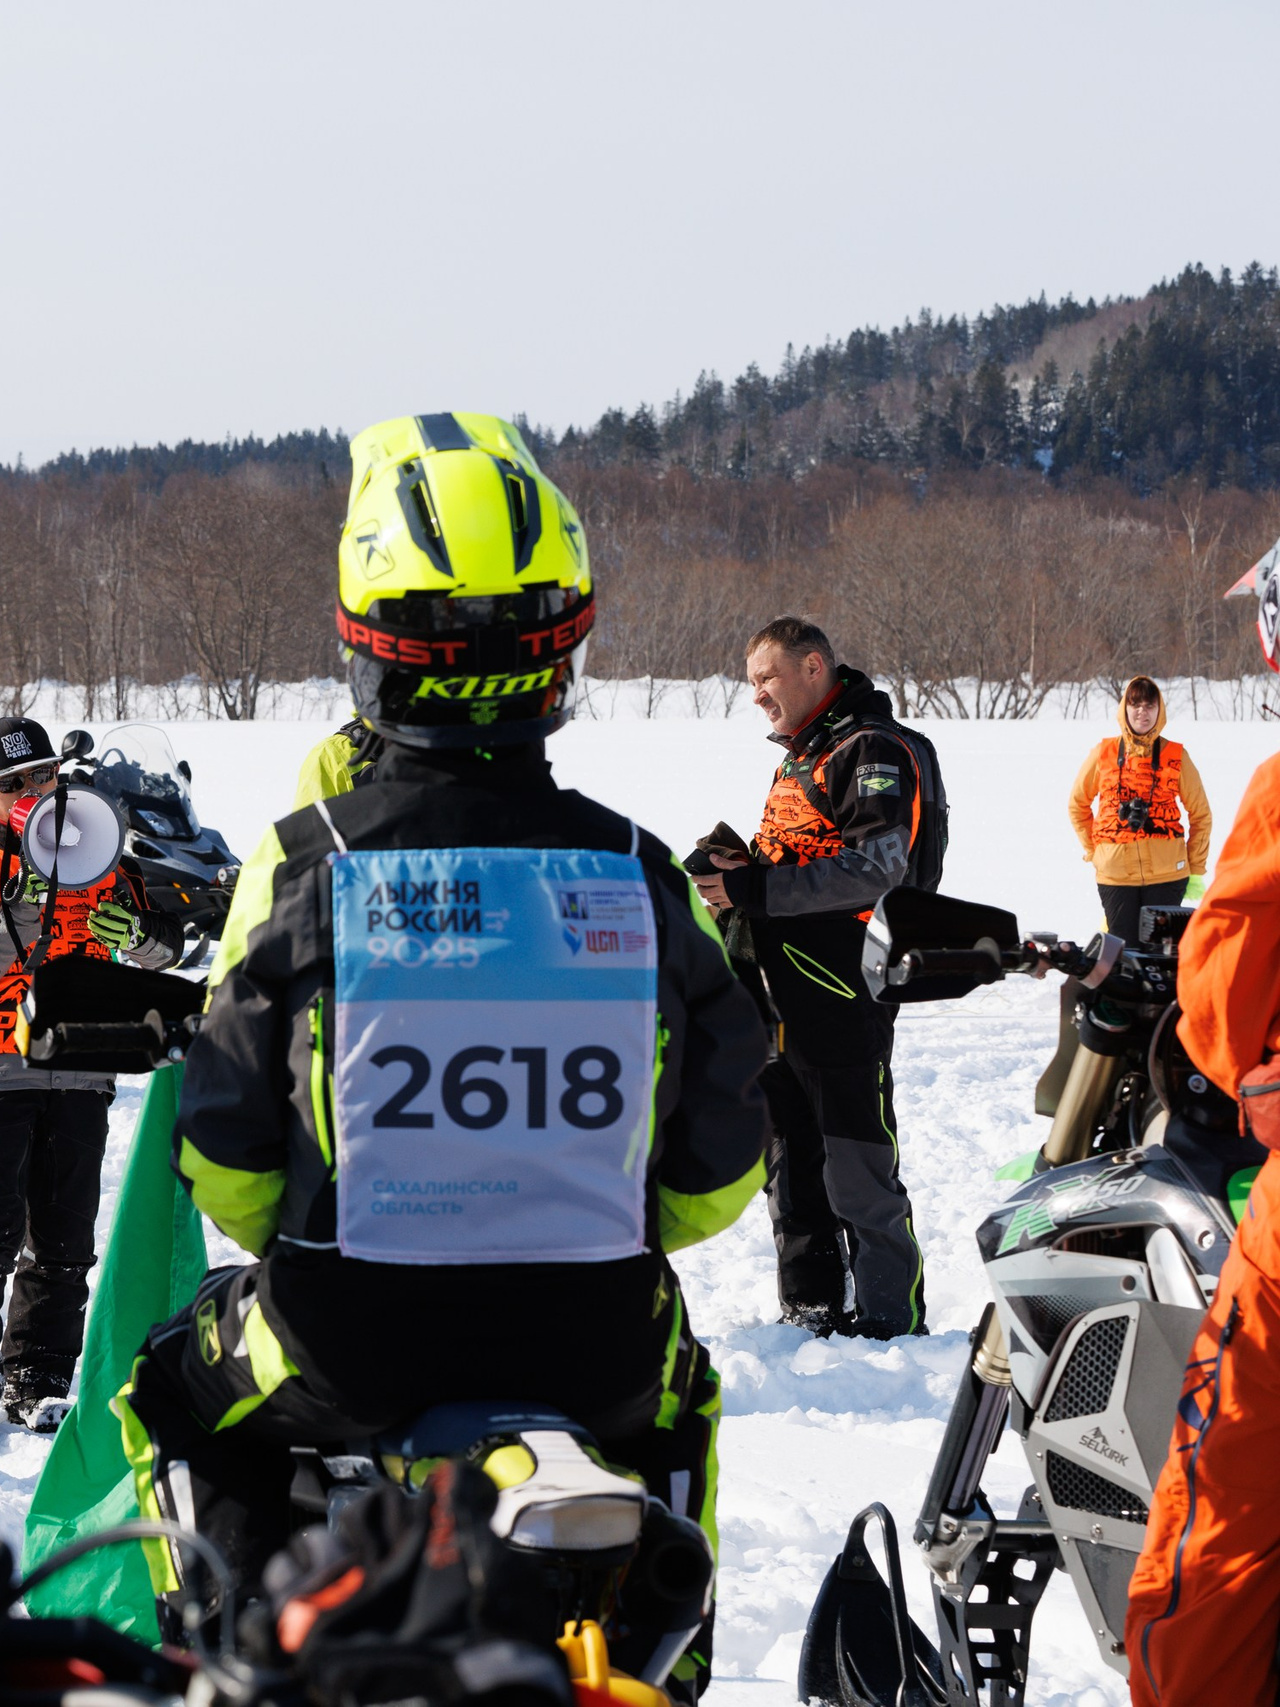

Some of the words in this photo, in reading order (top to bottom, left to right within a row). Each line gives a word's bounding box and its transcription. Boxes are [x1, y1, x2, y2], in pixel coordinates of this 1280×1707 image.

[1, 732, 23, 749] NO
[5, 743, 26, 755] PLACE
[858, 764, 877, 774] FXR
[365, 879, 480, 906] ЛЫЖНЯ
[367, 908, 482, 933] РОССИИ
[366, 935, 480, 969] 2025
[585, 930, 620, 954] ЦСП
[368, 1044, 624, 1130] 2618
[371, 1179, 519, 1195] САХАЛИНСКАЯ
[370, 1200, 464, 1216] ОБЛАСТЬ
[1079, 1434, 1130, 1467] SELKIRK
